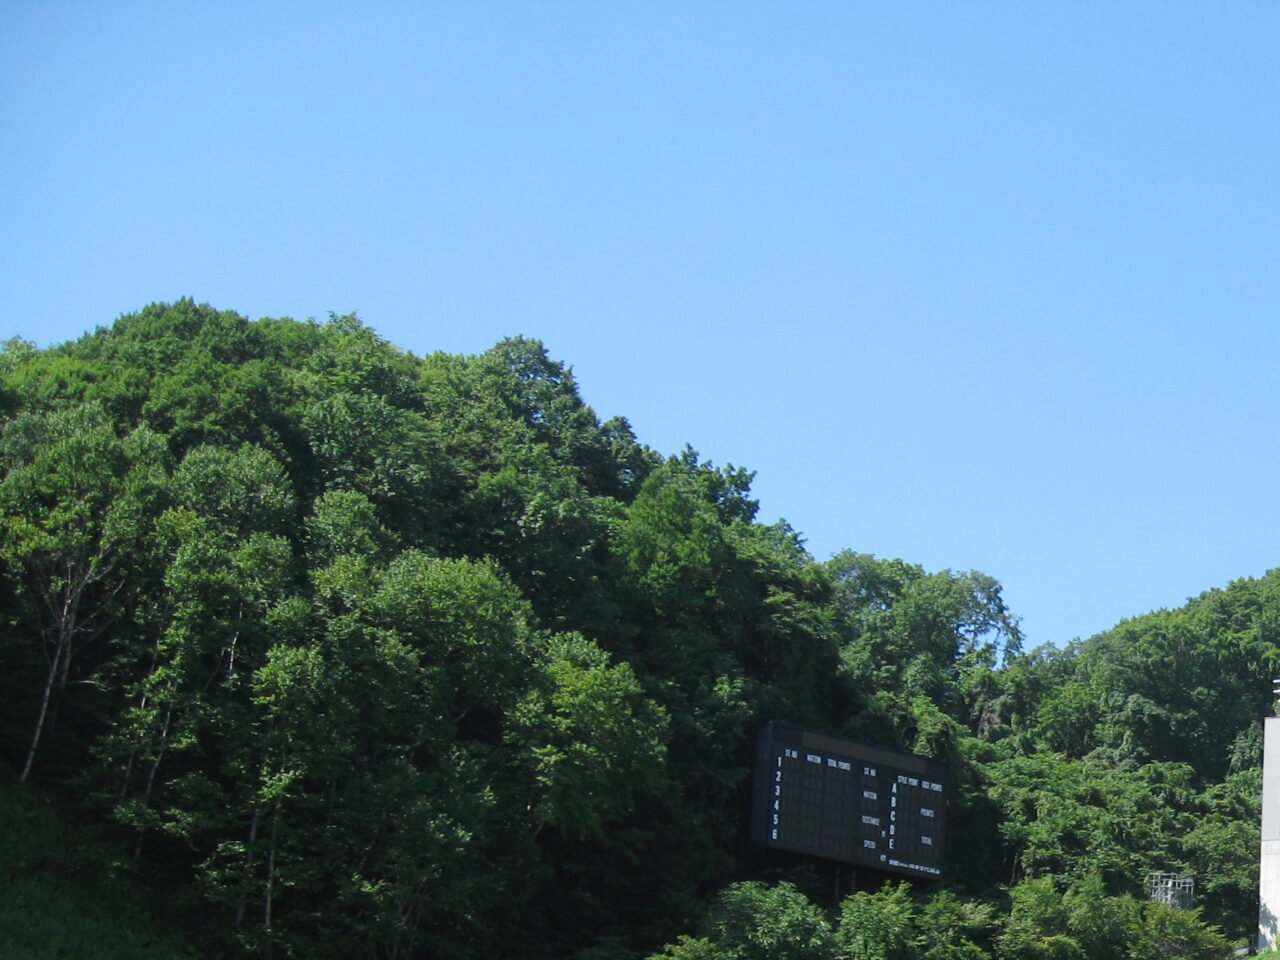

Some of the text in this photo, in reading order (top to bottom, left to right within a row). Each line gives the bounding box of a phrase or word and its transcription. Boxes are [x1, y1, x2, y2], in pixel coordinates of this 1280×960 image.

[776, 771, 781, 782] 2
[775, 785, 780, 796] 3
[892, 782, 897, 793] A
[774, 800, 779, 810] 4
[891, 796, 896, 807] B
[773, 814, 778, 825] 5
[890, 810, 895, 821] C
[772, 829, 777, 839] 6
[889, 825, 895, 835] D
[889, 838, 894, 849] E
